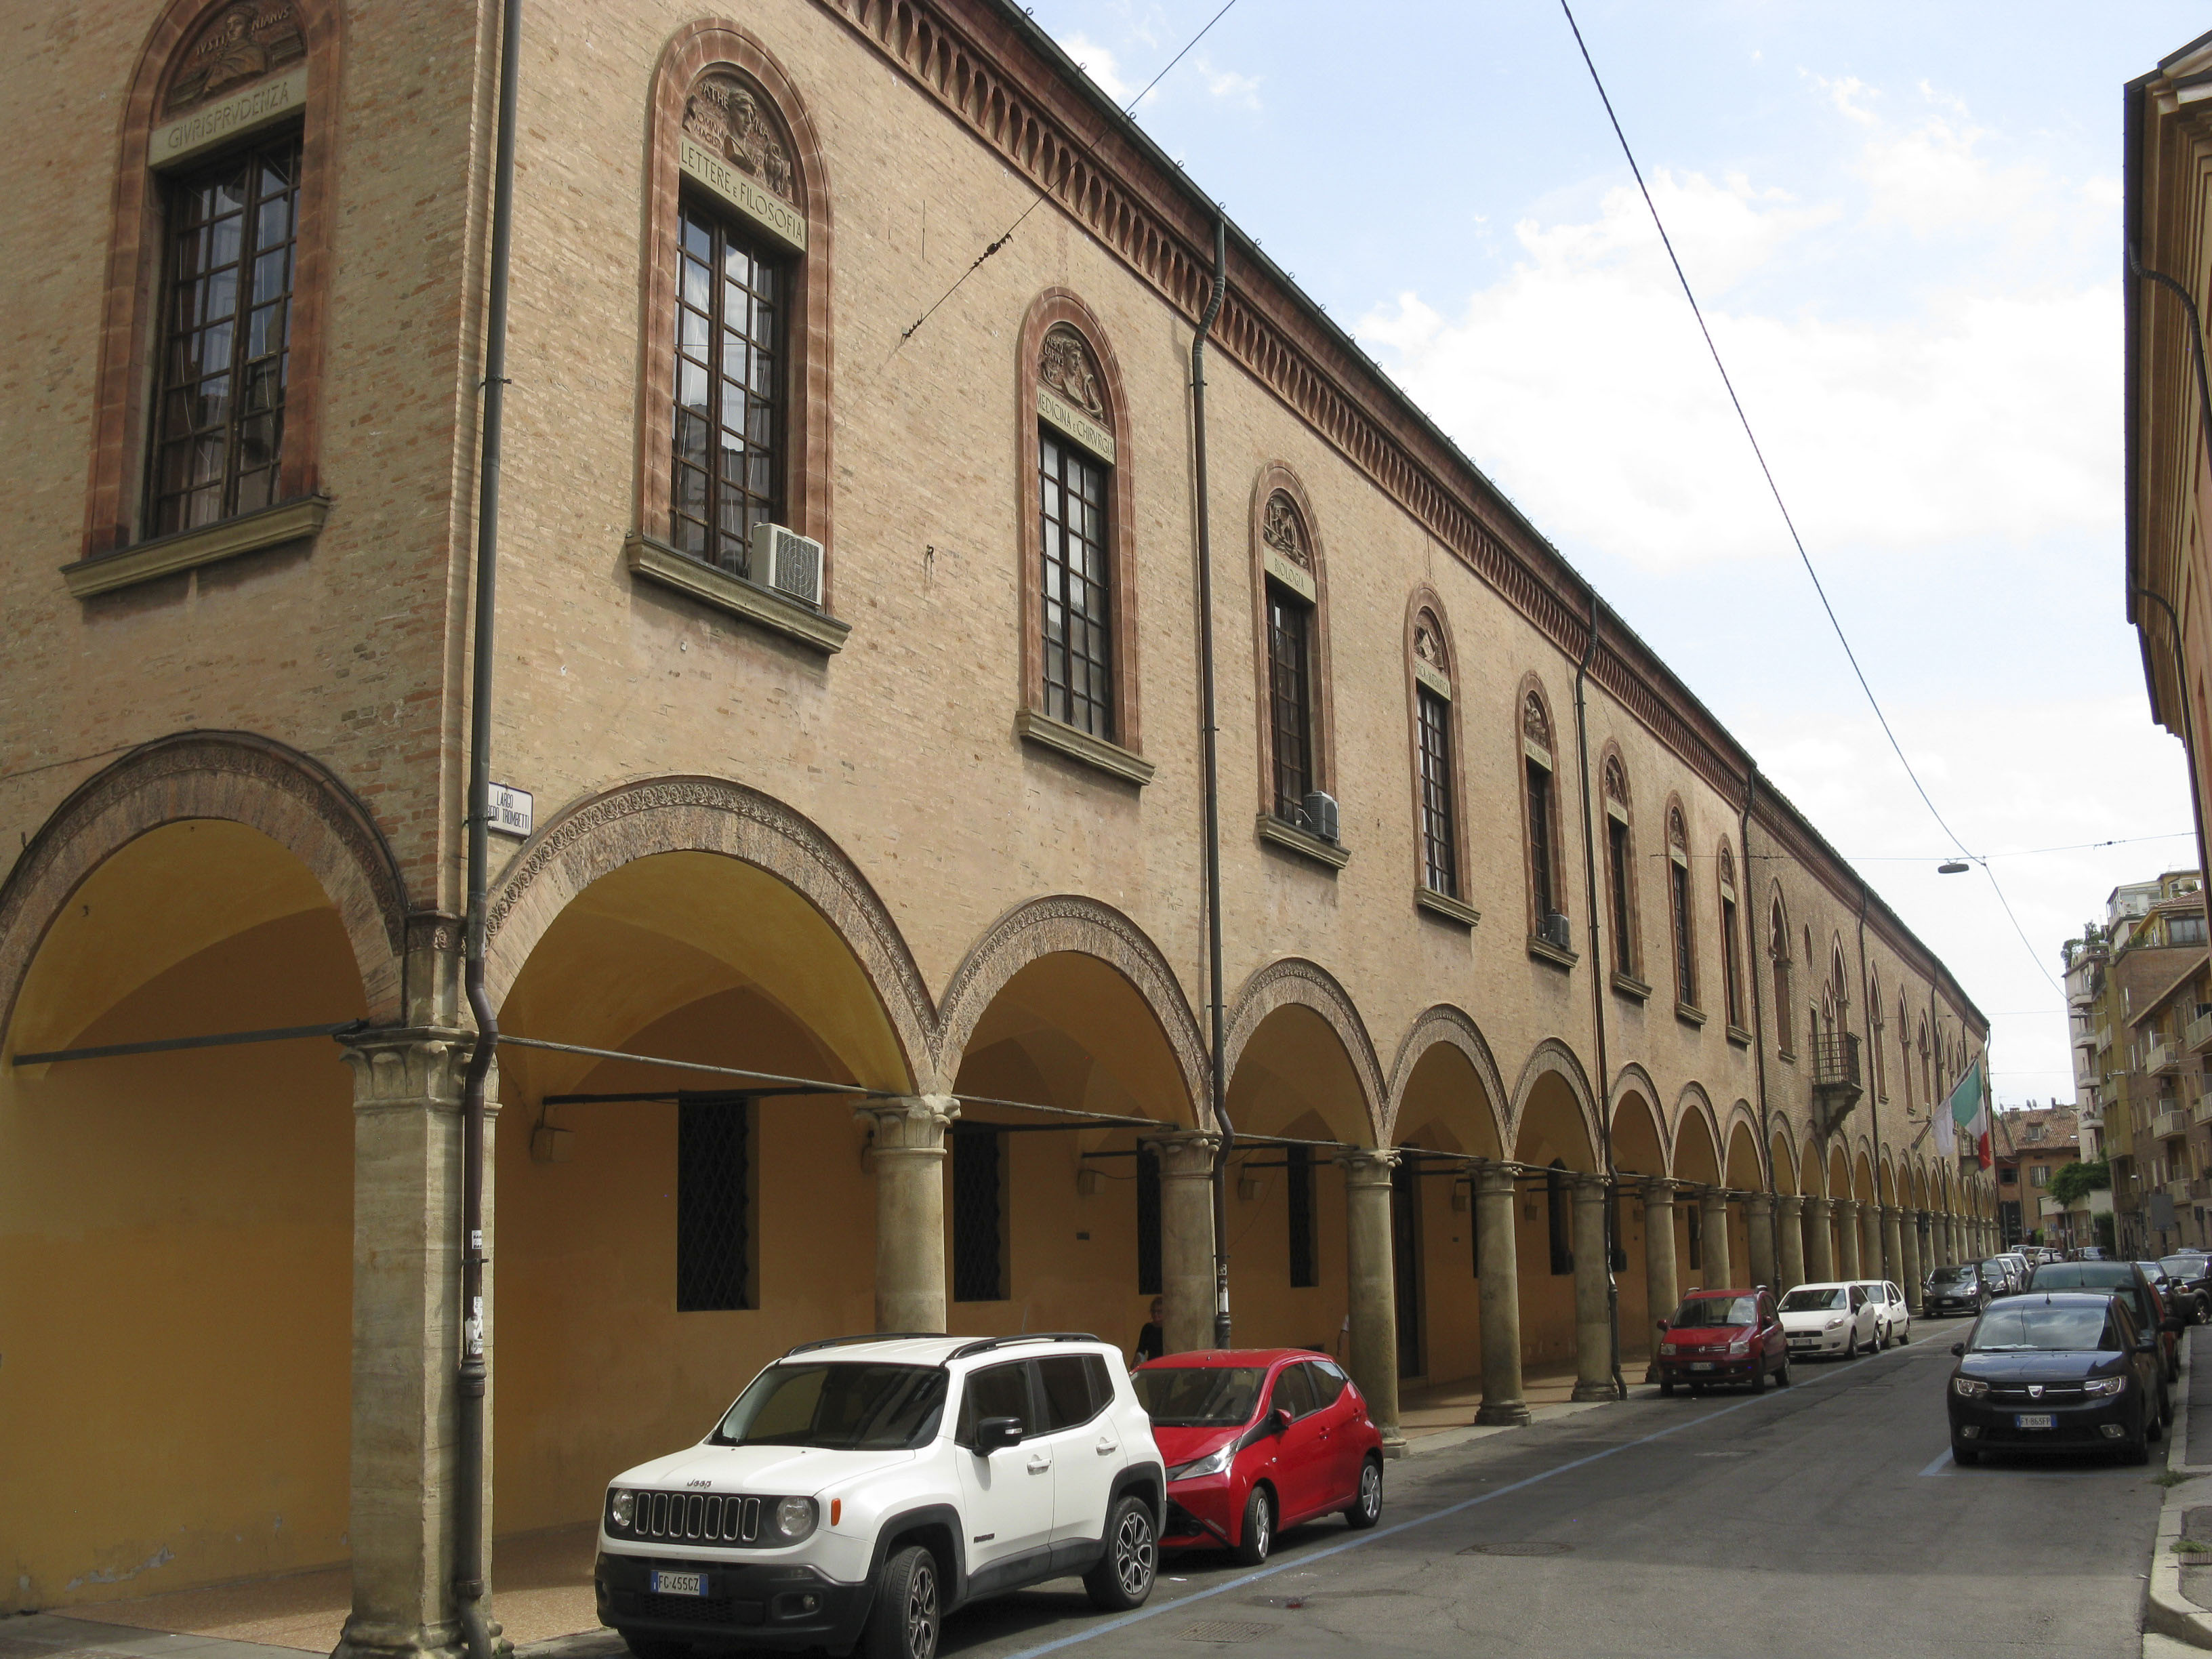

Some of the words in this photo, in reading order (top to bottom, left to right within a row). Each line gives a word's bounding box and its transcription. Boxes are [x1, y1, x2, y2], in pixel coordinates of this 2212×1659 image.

[681, 141, 731, 194] LETTERE
[740, 183, 802, 243] FILOSOFIA
[1037, 392, 1071, 430] MEDICINA
[1077, 421, 1114, 458] CHIRVRGIA
[1275, 558, 1304, 590] BIOLOGIA
[497, 791, 514, 808] LARGO
[502, 808, 529, 830] TROMBETTI
[687, 1479, 712, 1489] Jeep
